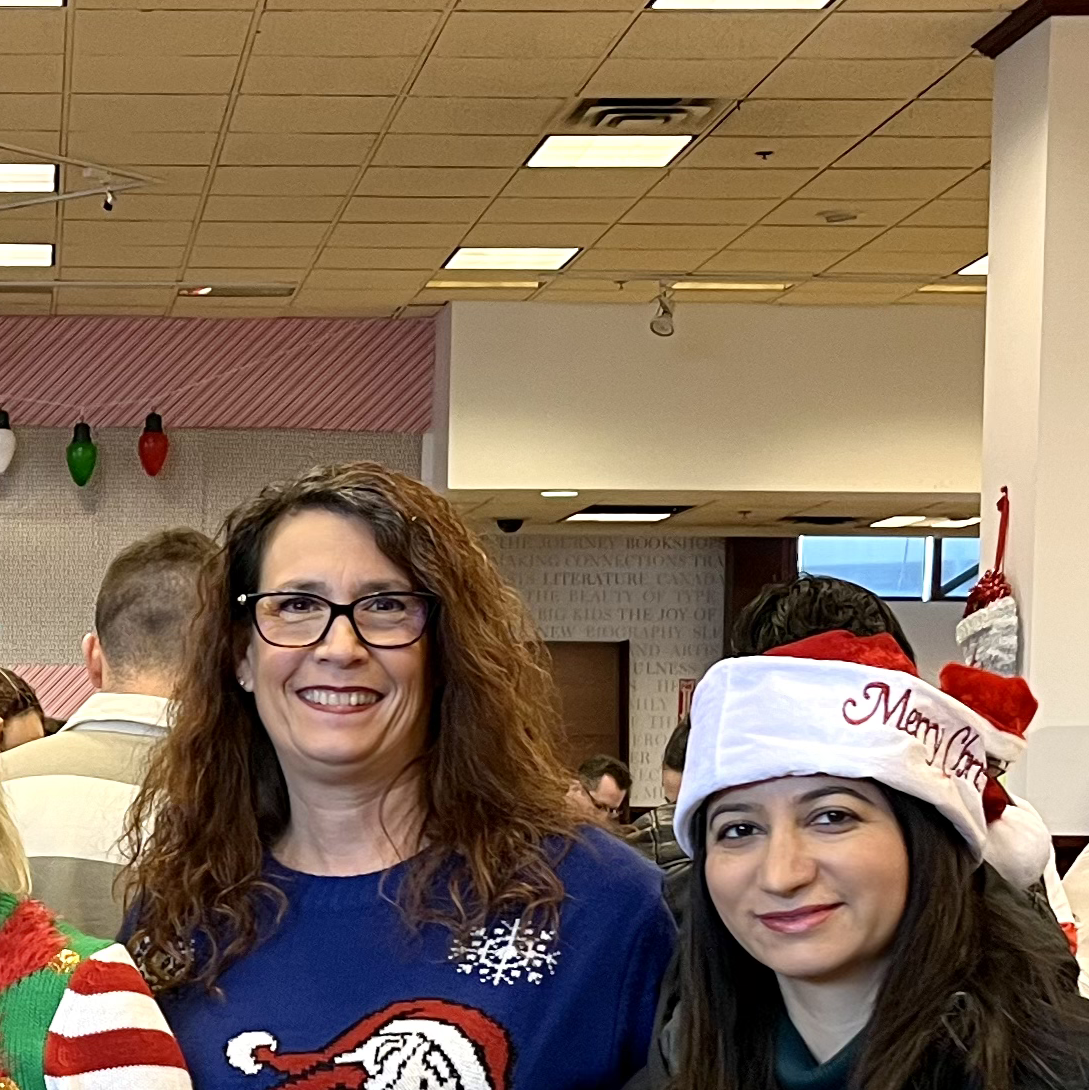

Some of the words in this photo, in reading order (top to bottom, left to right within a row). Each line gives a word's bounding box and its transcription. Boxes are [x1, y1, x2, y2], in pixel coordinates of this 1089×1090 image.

[565, 553, 687, 568] CONNECTIONS
[542, 571, 645, 587] LITERATURE
[618, 607, 653, 621] THE
[659, 607, 689, 622] JOY
[693, 607, 716, 622] OF
[842, 682, 946, 767] Merry
